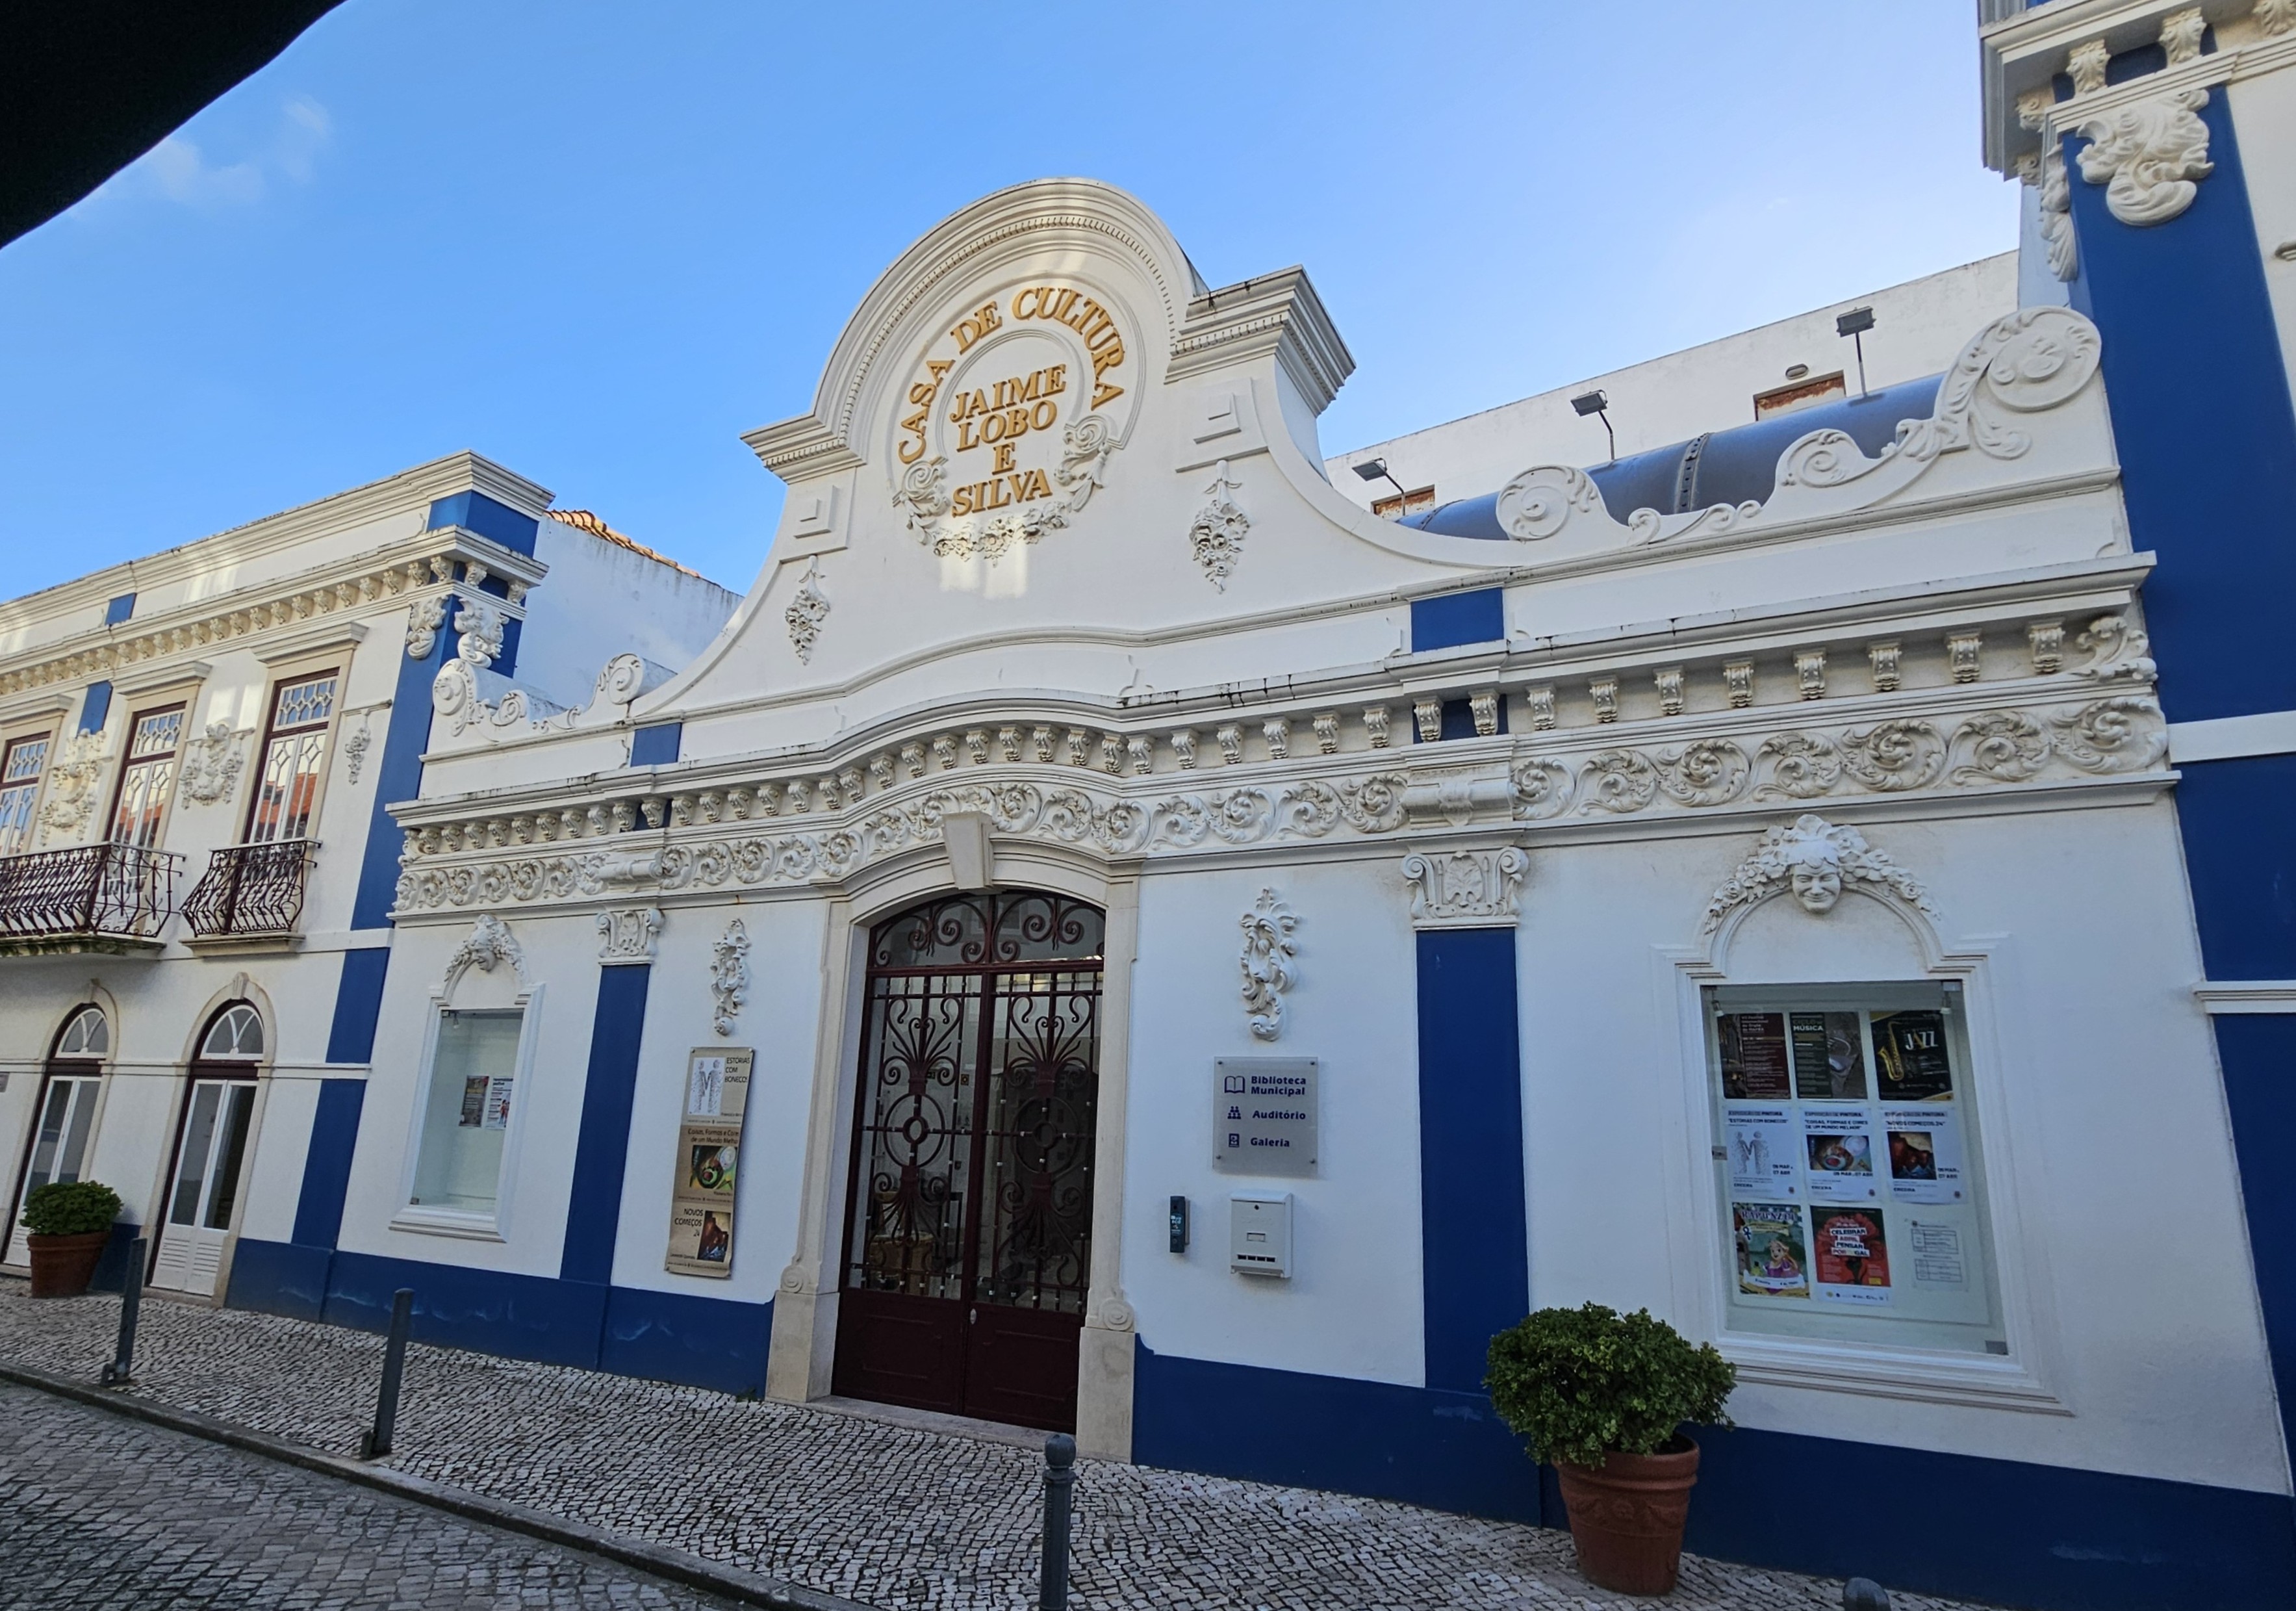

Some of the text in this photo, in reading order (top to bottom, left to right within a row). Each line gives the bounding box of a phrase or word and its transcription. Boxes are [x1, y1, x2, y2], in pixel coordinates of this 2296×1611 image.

[898, 287, 1126, 465] CASA DE CULTURA
[949, 364, 1066, 423] JAIME
[956, 400, 1058, 452] LOBO
[991, 442, 1016, 475] E
[952, 469, 1052, 517] SILVA
[1905, 1031, 1939, 1050] JAZZ
[1251, 1076, 1306, 1085] Biblioteca
[1251, 1087, 1305, 1097] Municipal
[1252, 1110, 1306, 1120] Auditório
[1250, 1137, 1290, 1147] Galeria
[684, 1208, 704, 1217] NOVOS
[674, 1218, 702, 1227] COMEÇOS
